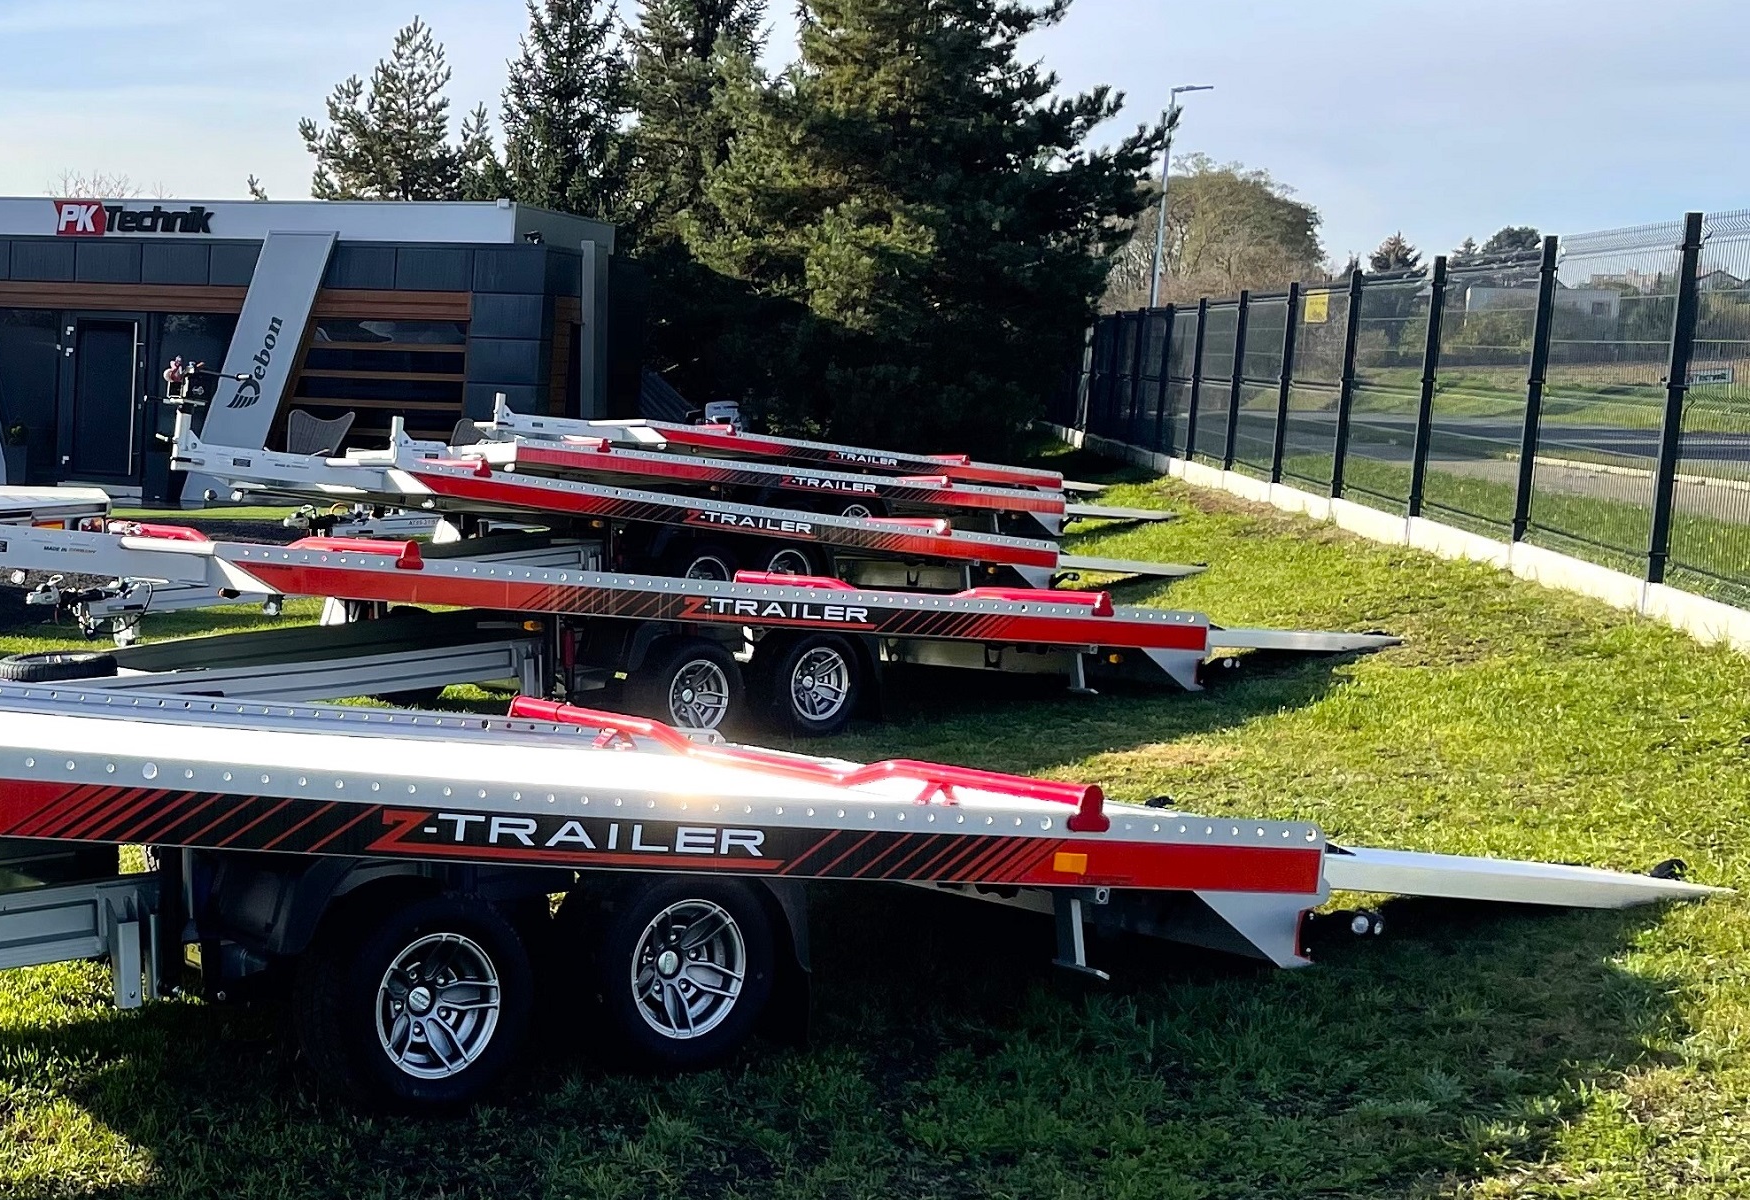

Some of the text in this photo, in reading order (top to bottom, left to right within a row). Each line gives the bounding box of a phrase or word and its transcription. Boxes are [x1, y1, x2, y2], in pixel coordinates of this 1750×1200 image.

[58, 204, 215, 234] PK Technik
[826, 450, 901, 469] Z-TRAILER
[779, 475, 879, 497] Z-TRAILER
[682, 508, 815, 538] Z-TRAILER
[677, 597, 873, 629] Z-TRAILER
[364, 808, 778, 868] Z-TRAILER
